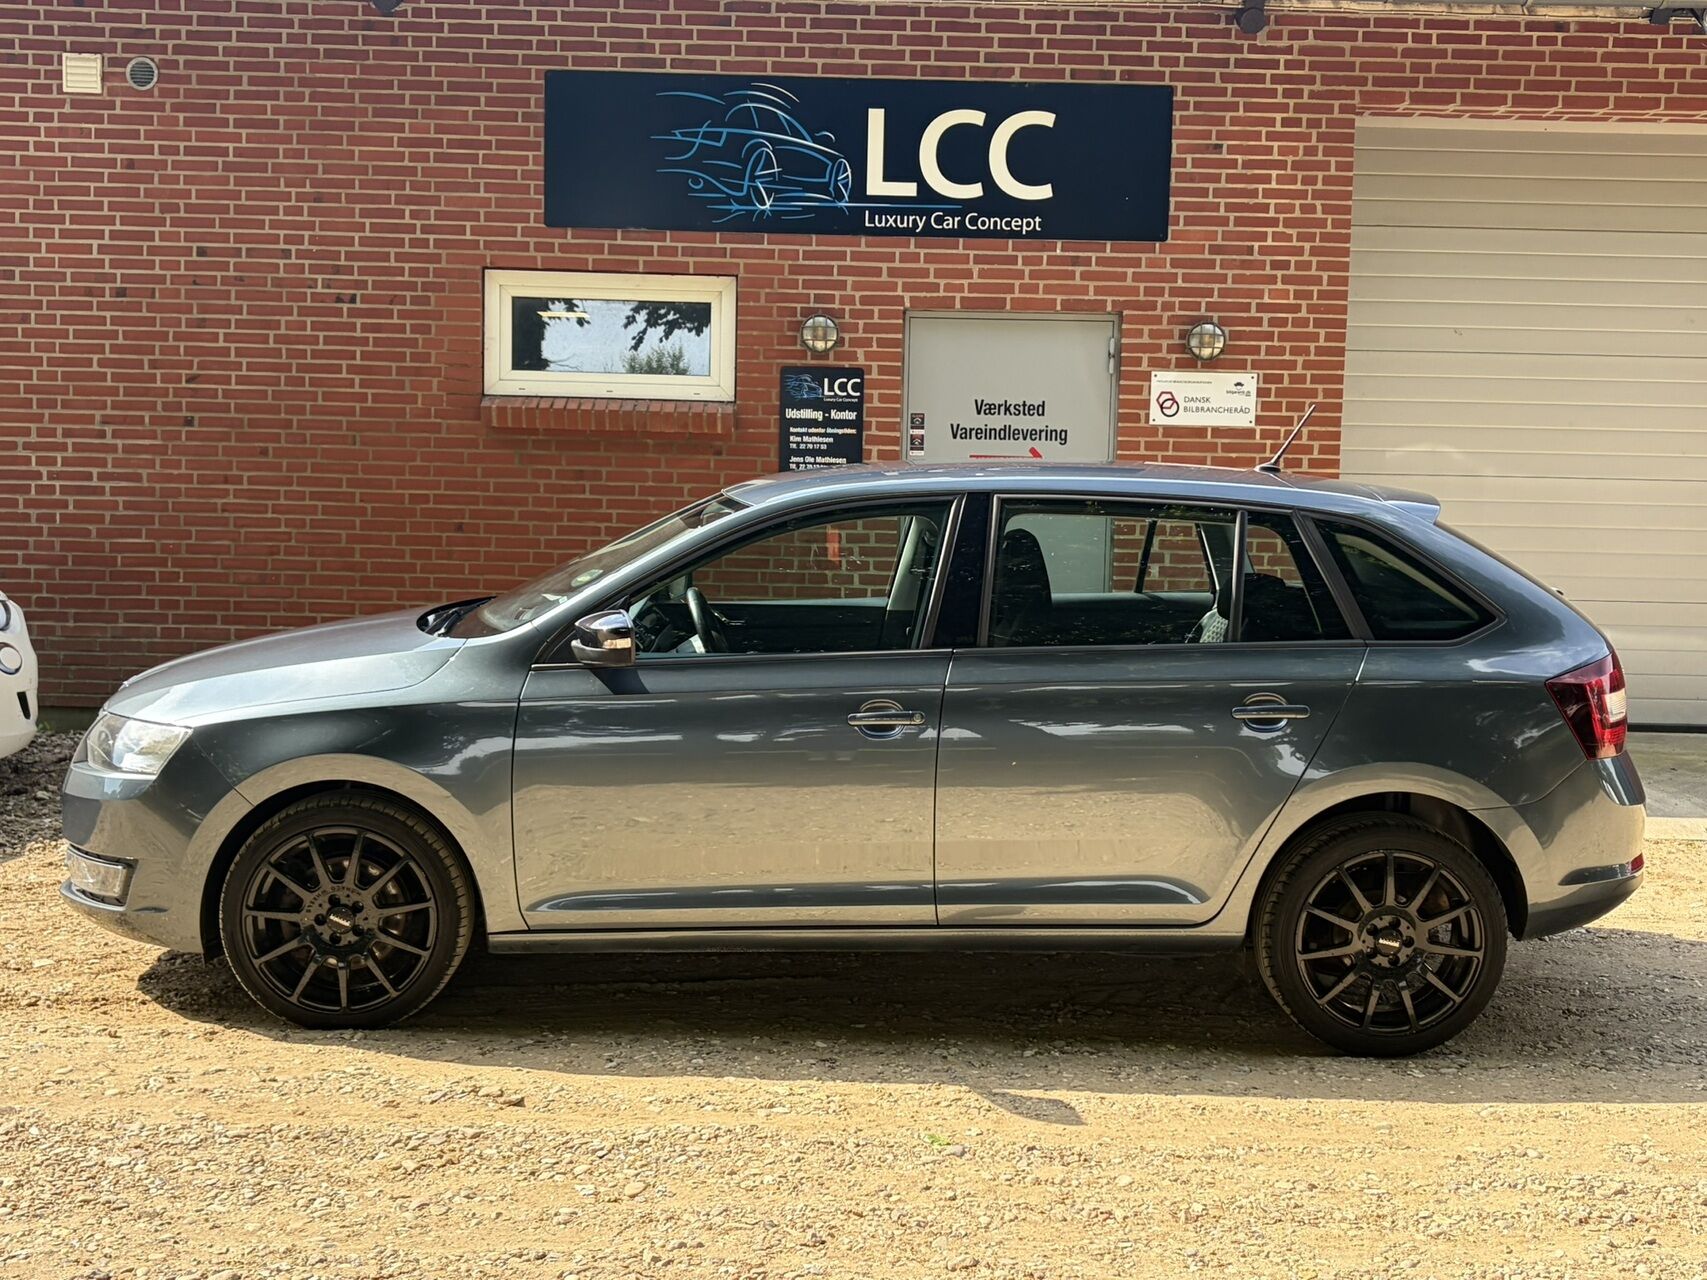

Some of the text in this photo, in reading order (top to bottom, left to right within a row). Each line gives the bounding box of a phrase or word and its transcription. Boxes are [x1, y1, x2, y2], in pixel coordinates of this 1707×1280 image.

[866, 108, 1057, 200] LCC
[864, 210, 1042, 235] Luxury Car Concept
[824, 378, 861, 396] LCC
[974, 399, 1046, 417] Værksted
[1183, 396, 1212, 404] DANSK
[785, 408, 823, 421] Udstilling
[830, 409, 857, 420] Kontor
[1183, 405, 1251, 415] BILBRANCHERÅD
[949, 423, 1069, 446] Vareindlevering
[815, 456, 847, 464] Mathiesen
